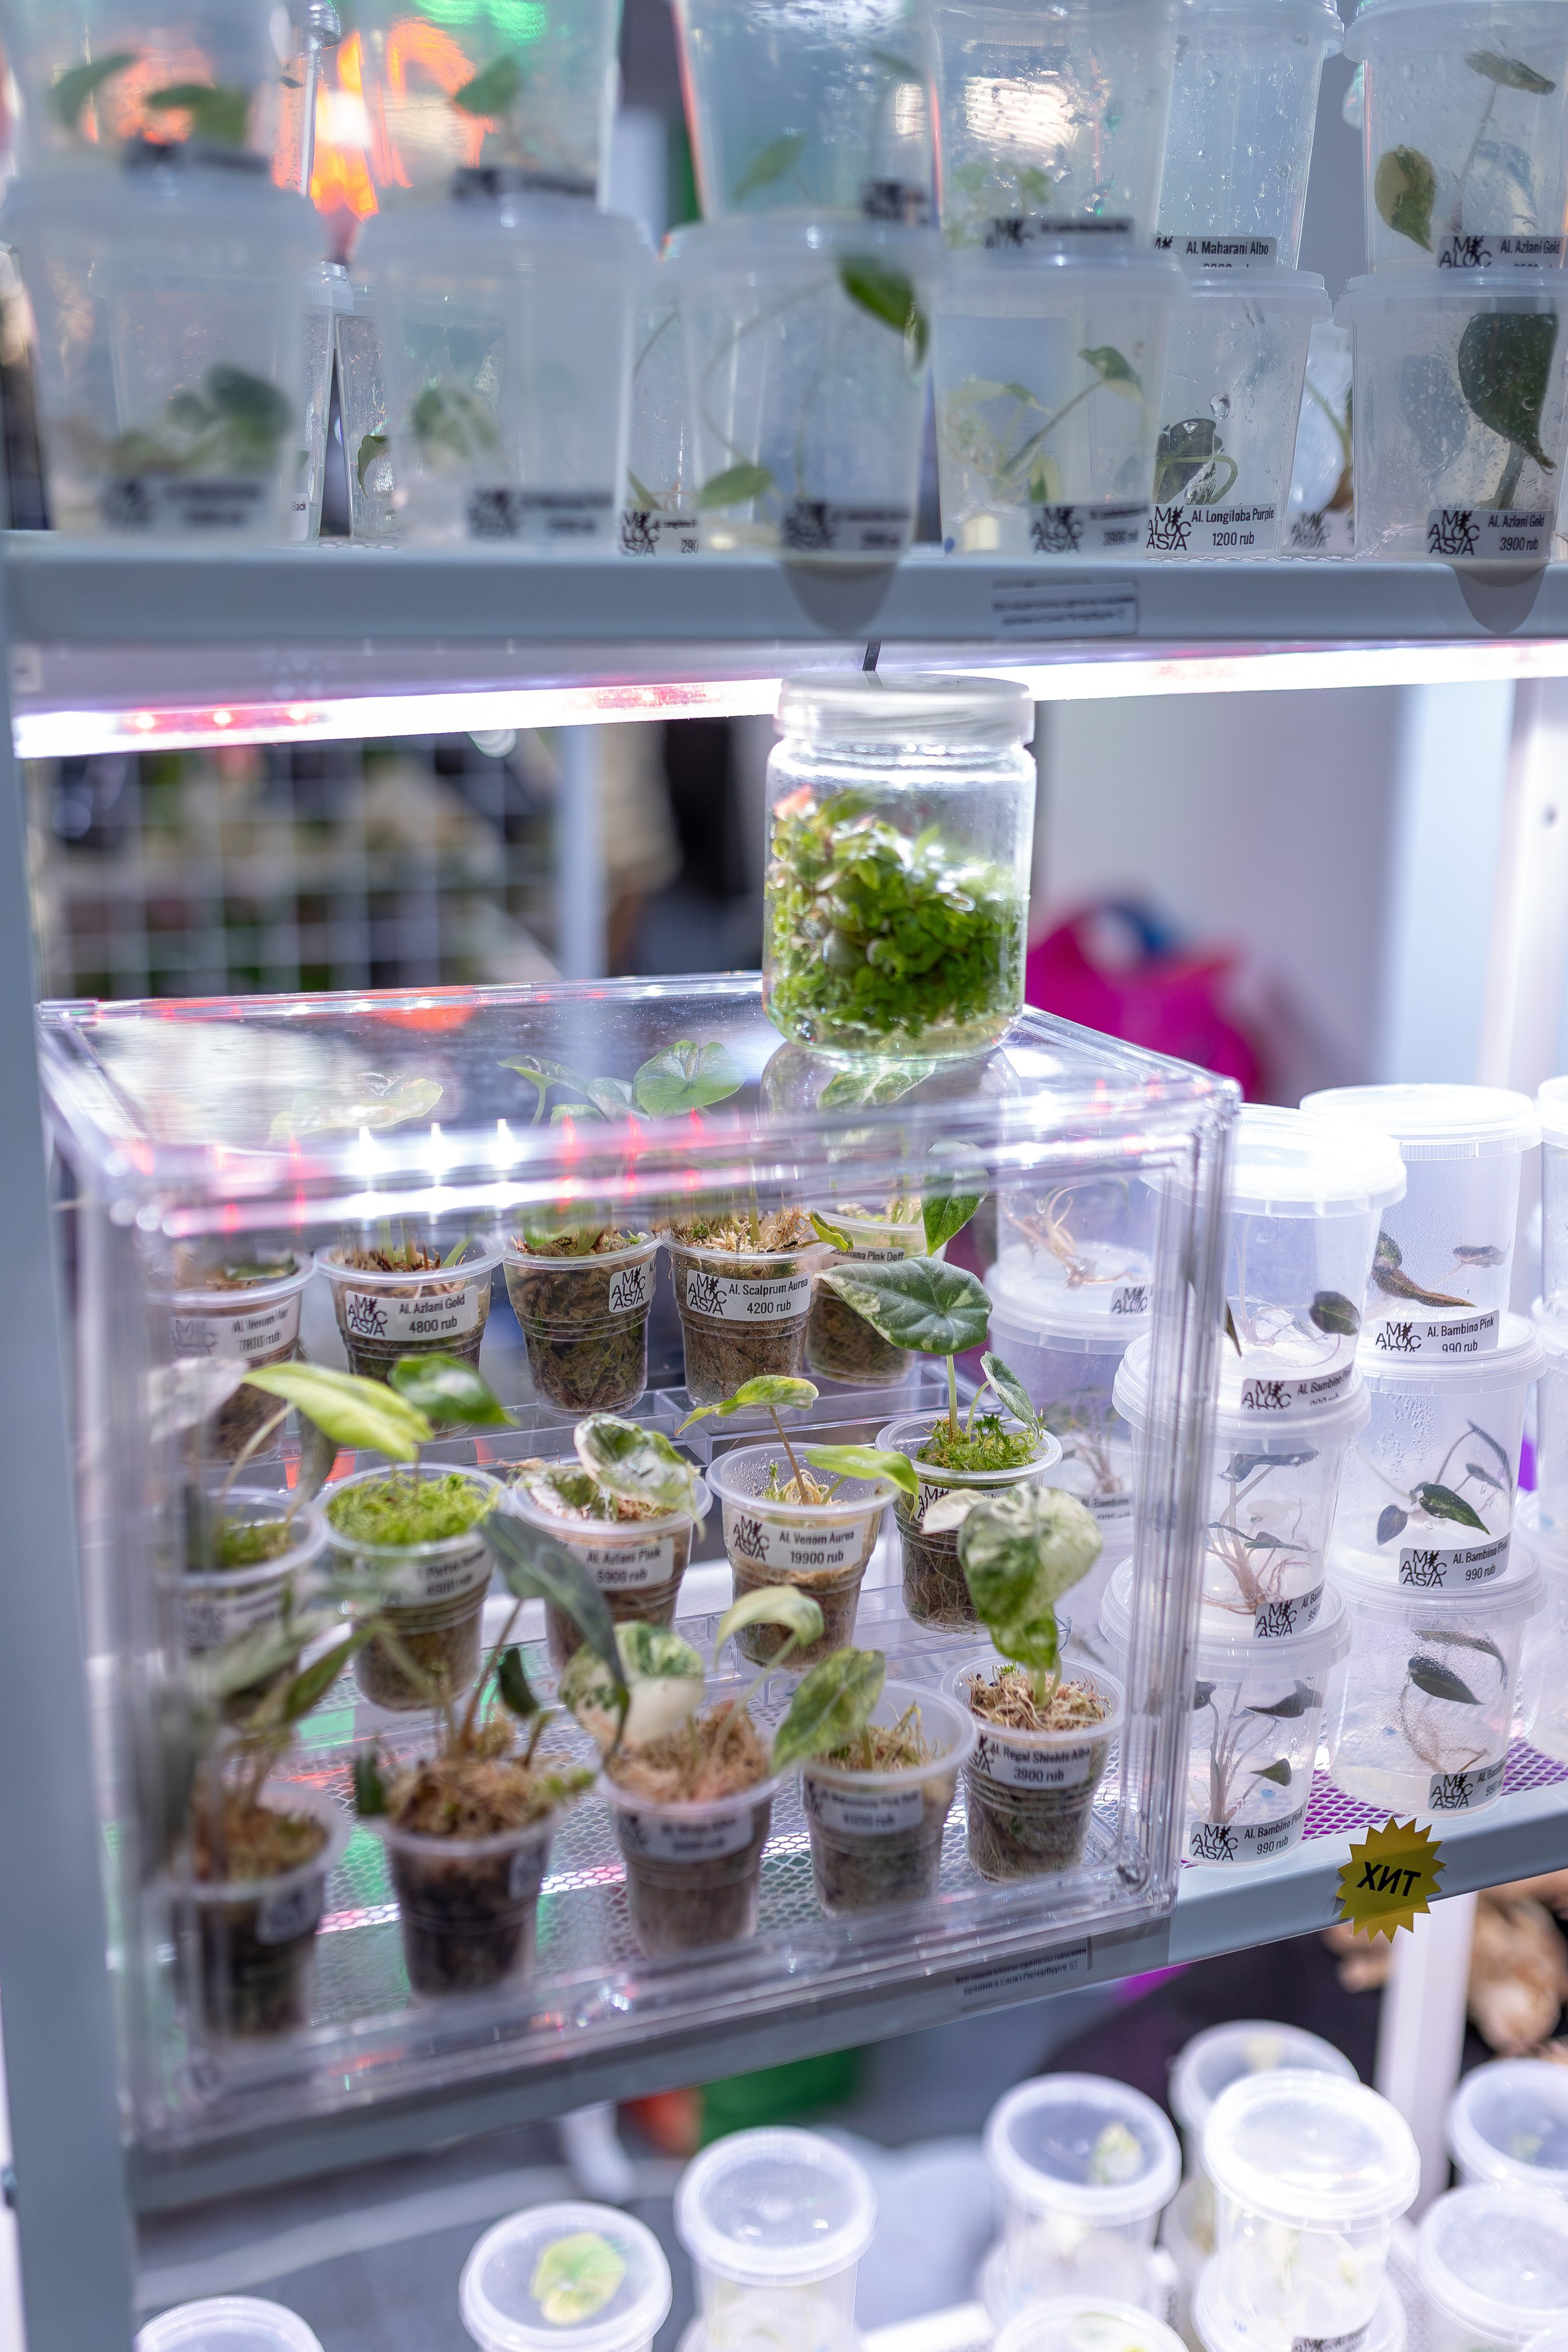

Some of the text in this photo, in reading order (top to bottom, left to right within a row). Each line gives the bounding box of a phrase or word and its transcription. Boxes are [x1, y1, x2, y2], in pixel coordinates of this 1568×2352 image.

[1186, 241, 1268, 255] Al. Maharani Albo
[1515, 239, 1541, 254] Azlani
[1543, 239, 1561, 254] Gold
[1439, 251, 1492, 268] ALOC
[1191, 507, 1274, 525] Al. Longiloba Purple
[1502, 513, 1528, 528] Azlani
[1529, 514, 1545, 527] Gold
[624, 526, 659, 542] LOC
[1148, 519, 1192, 537] ALOC
[1428, 524, 1480, 541] ALOC
[1147, 533, 1187, 551] ASIA
[1212, 531, 1254, 546] 1200 rub
[1428, 538, 1474, 555] ASIA
[1499, 537, 1539, 551] 3900 rub
[867, 1251, 885, 1261] Pink
[887, 1251, 904, 1262] Doff
[611, 1276, 646, 1298] ALOC
[688, 1283, 727, 1304] ALOC
[729, 1278, 808, 1297] Al. Scalprum Aurea
[399, 1294, 465, 1314] Al. Azlani Gold
[612, 1289, 644, 1310] ASIA
[690, 1295, 724, 1316] ASIA
[747, 1300, 791, 1314] 4200 rub
[348, 1305, 388, 1324] ALOC
[350, 1316, 385, 1337] ASIA
[409, 1316, 458, 1333] 4800 rub
[1427, 1316, 1494, 1337] Al. Bambino Pink
[1376, 1333, 1421, 1348] ALOC
[1442, 1340, 1478, 1352] 990 rub
[1311, 1376, 1341, 1393] Bambino
[1242, 1392, 1291, 1408] ALOC
[733, 1524, 770, 1550] ALOC
[794, 1532, 827, 1545] Venom
[829, 1531, 854, 1543] Aurea
[735, 1536, 765, 1561] ASIA
[1453, 1553, 1464, 1564] Al.
[1466, 1548, 1496, 1562] Bambino
[791, 1550, 844, 1565] 19900 rub
[1401, 1560, 1447, 1575] ALOC
[1466, 1563, 1496, 1581] 990 rub
[1403, 1572, 1443, 1587] ASIA
[1256, 1610, 1297, 1629] ALOC
[1258, 1623, 1292, 1638] ASIA
[1014, 1767, 1064, 1782] 3900 rub
[1431, 1784, 1474, 1798] ALOC
[1432, 1795, 1469, 1809] ASIA
[1245, 1829, 1255, 1839] Al.
[1257, 1821, 1291, 1837] Bambino
[1191, 1833, 1238, 1850] ALOC
[1256, 1836, 1288, 1855] 990 rub
[1193, 1845, 1234, 1861] ASIA
[1356, 1861, 1422, 1897] ХИТ
